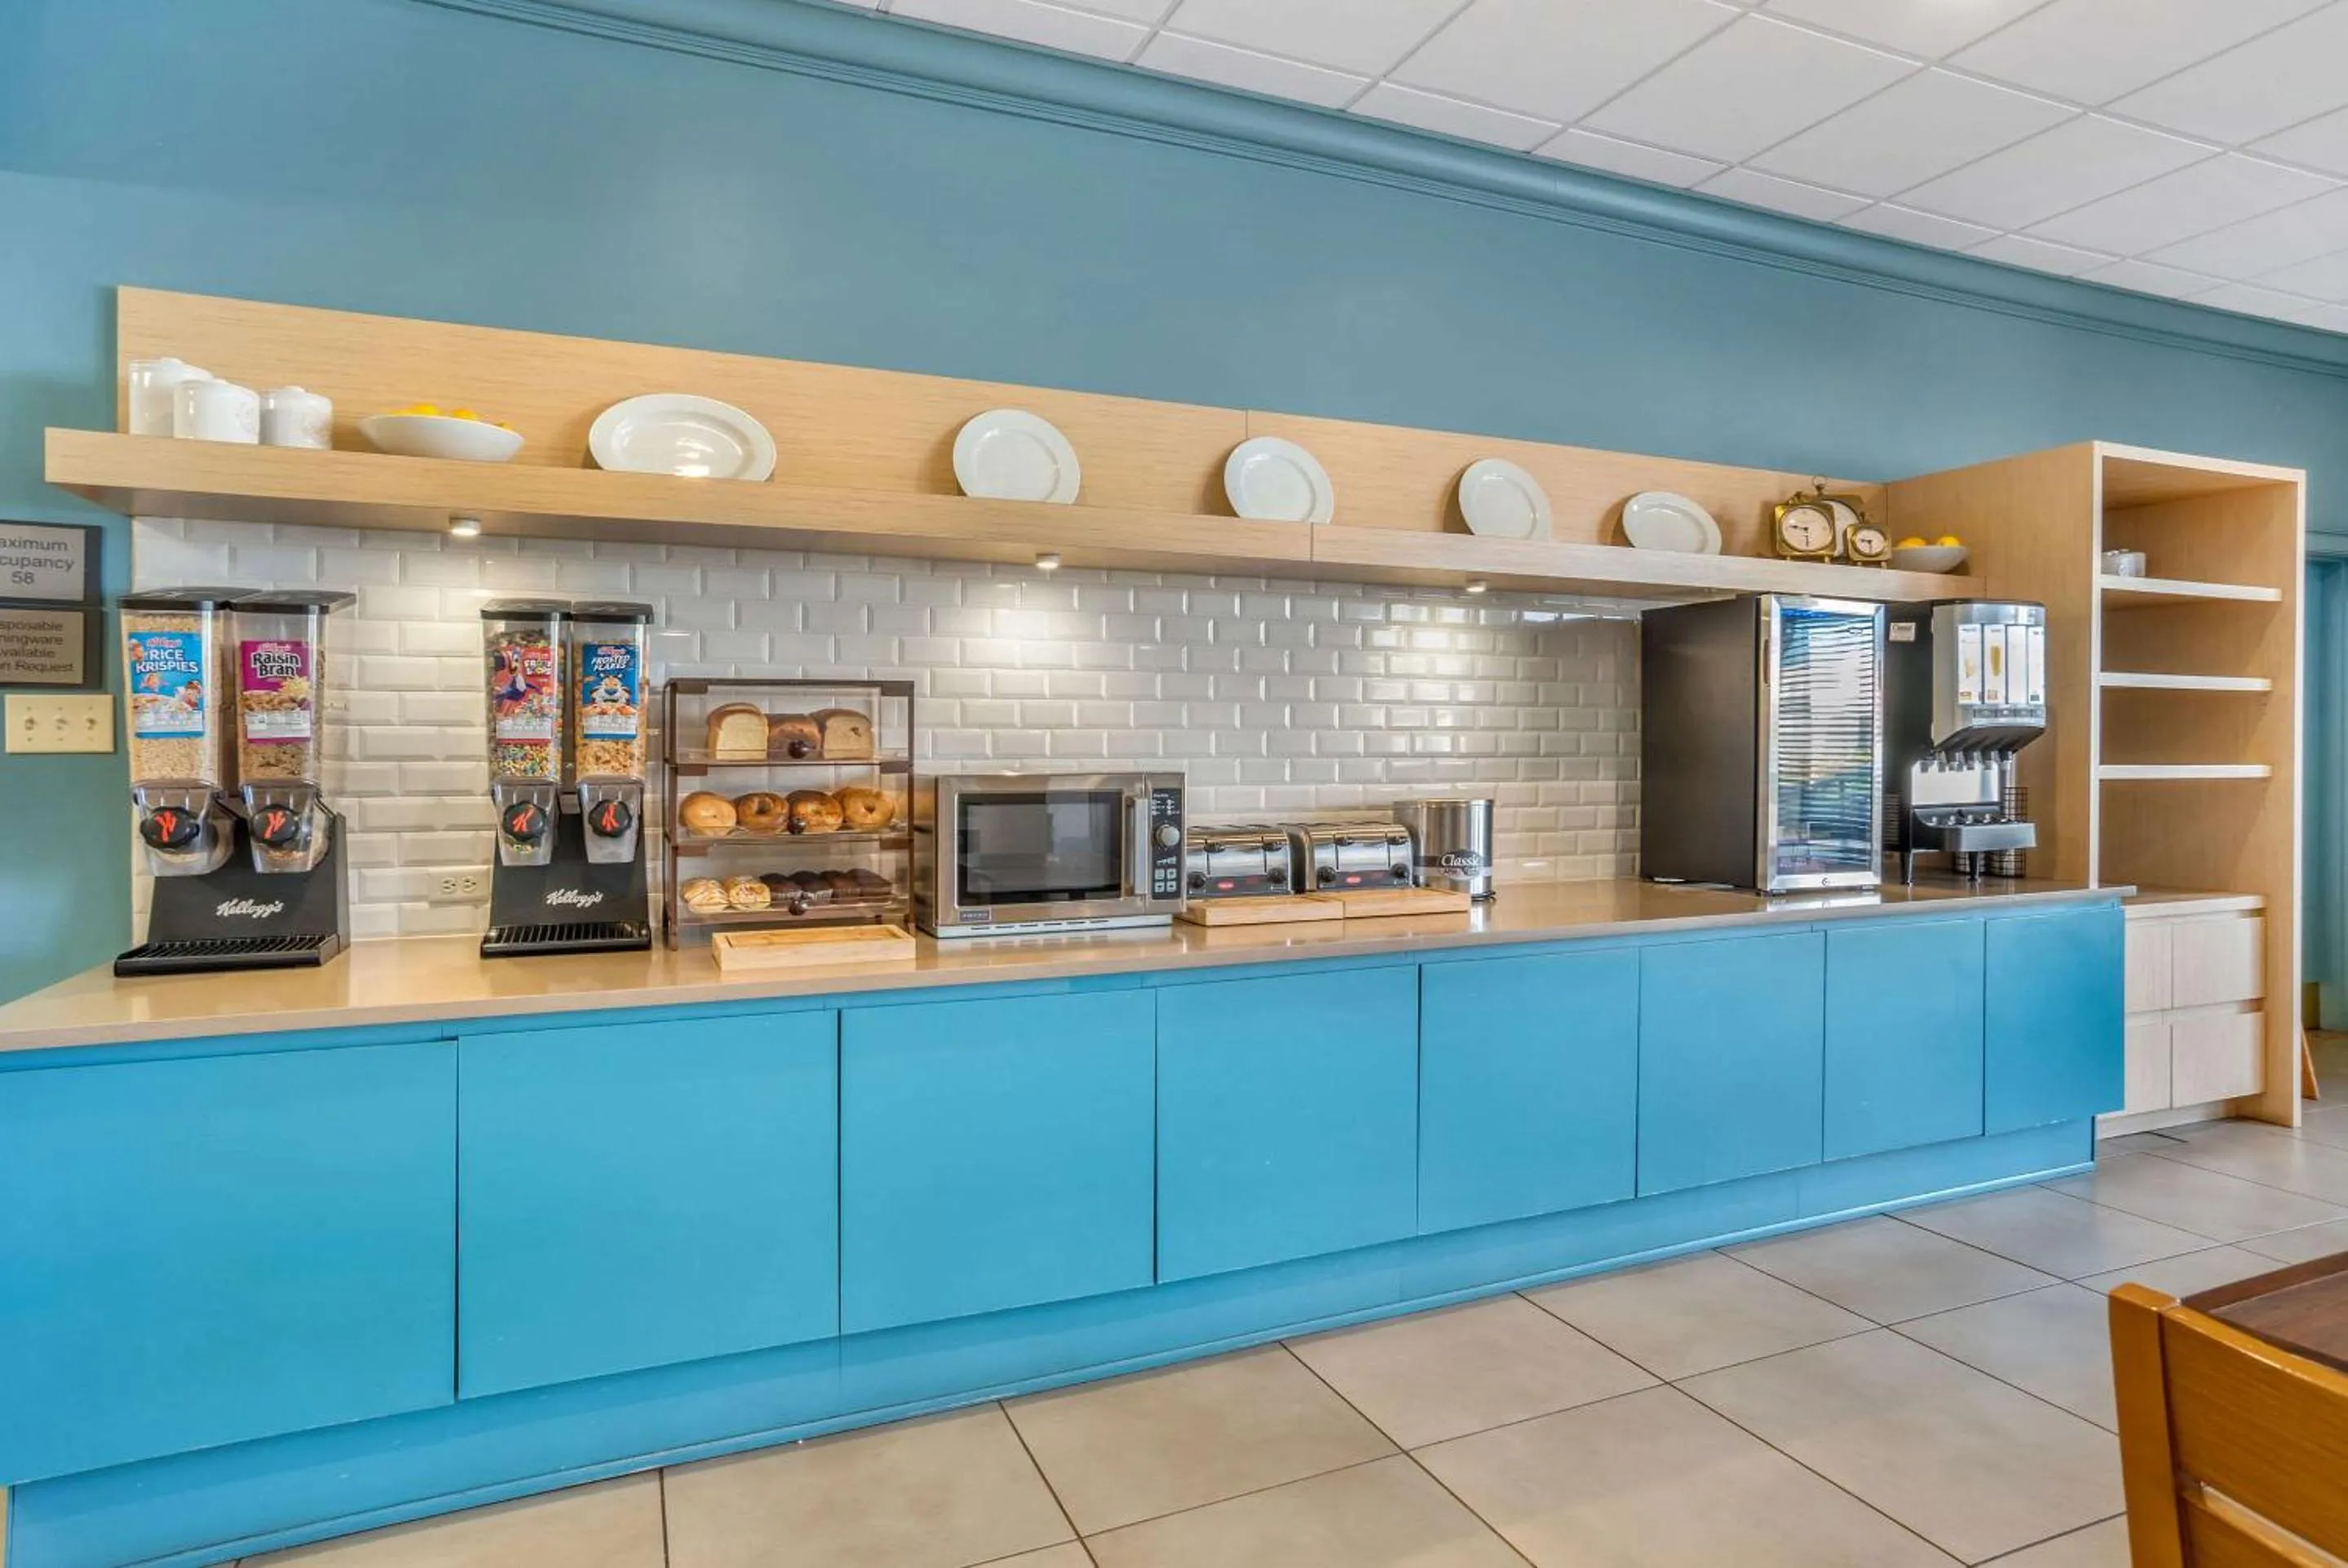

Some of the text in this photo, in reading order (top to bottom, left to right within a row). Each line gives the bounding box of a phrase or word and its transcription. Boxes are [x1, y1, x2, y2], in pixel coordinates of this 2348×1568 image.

[12, 571, 34, 585] 58
[149, 649, 184, 660] RICE
[252, 652, 300, 666] Raisin
[135, 661, 199, 673] KRISPIES
[259, 665, 296, 677] Bran
[546, 889, 604, 908] Kellogg's
[214, 899, 285, 919] Kellogg's
